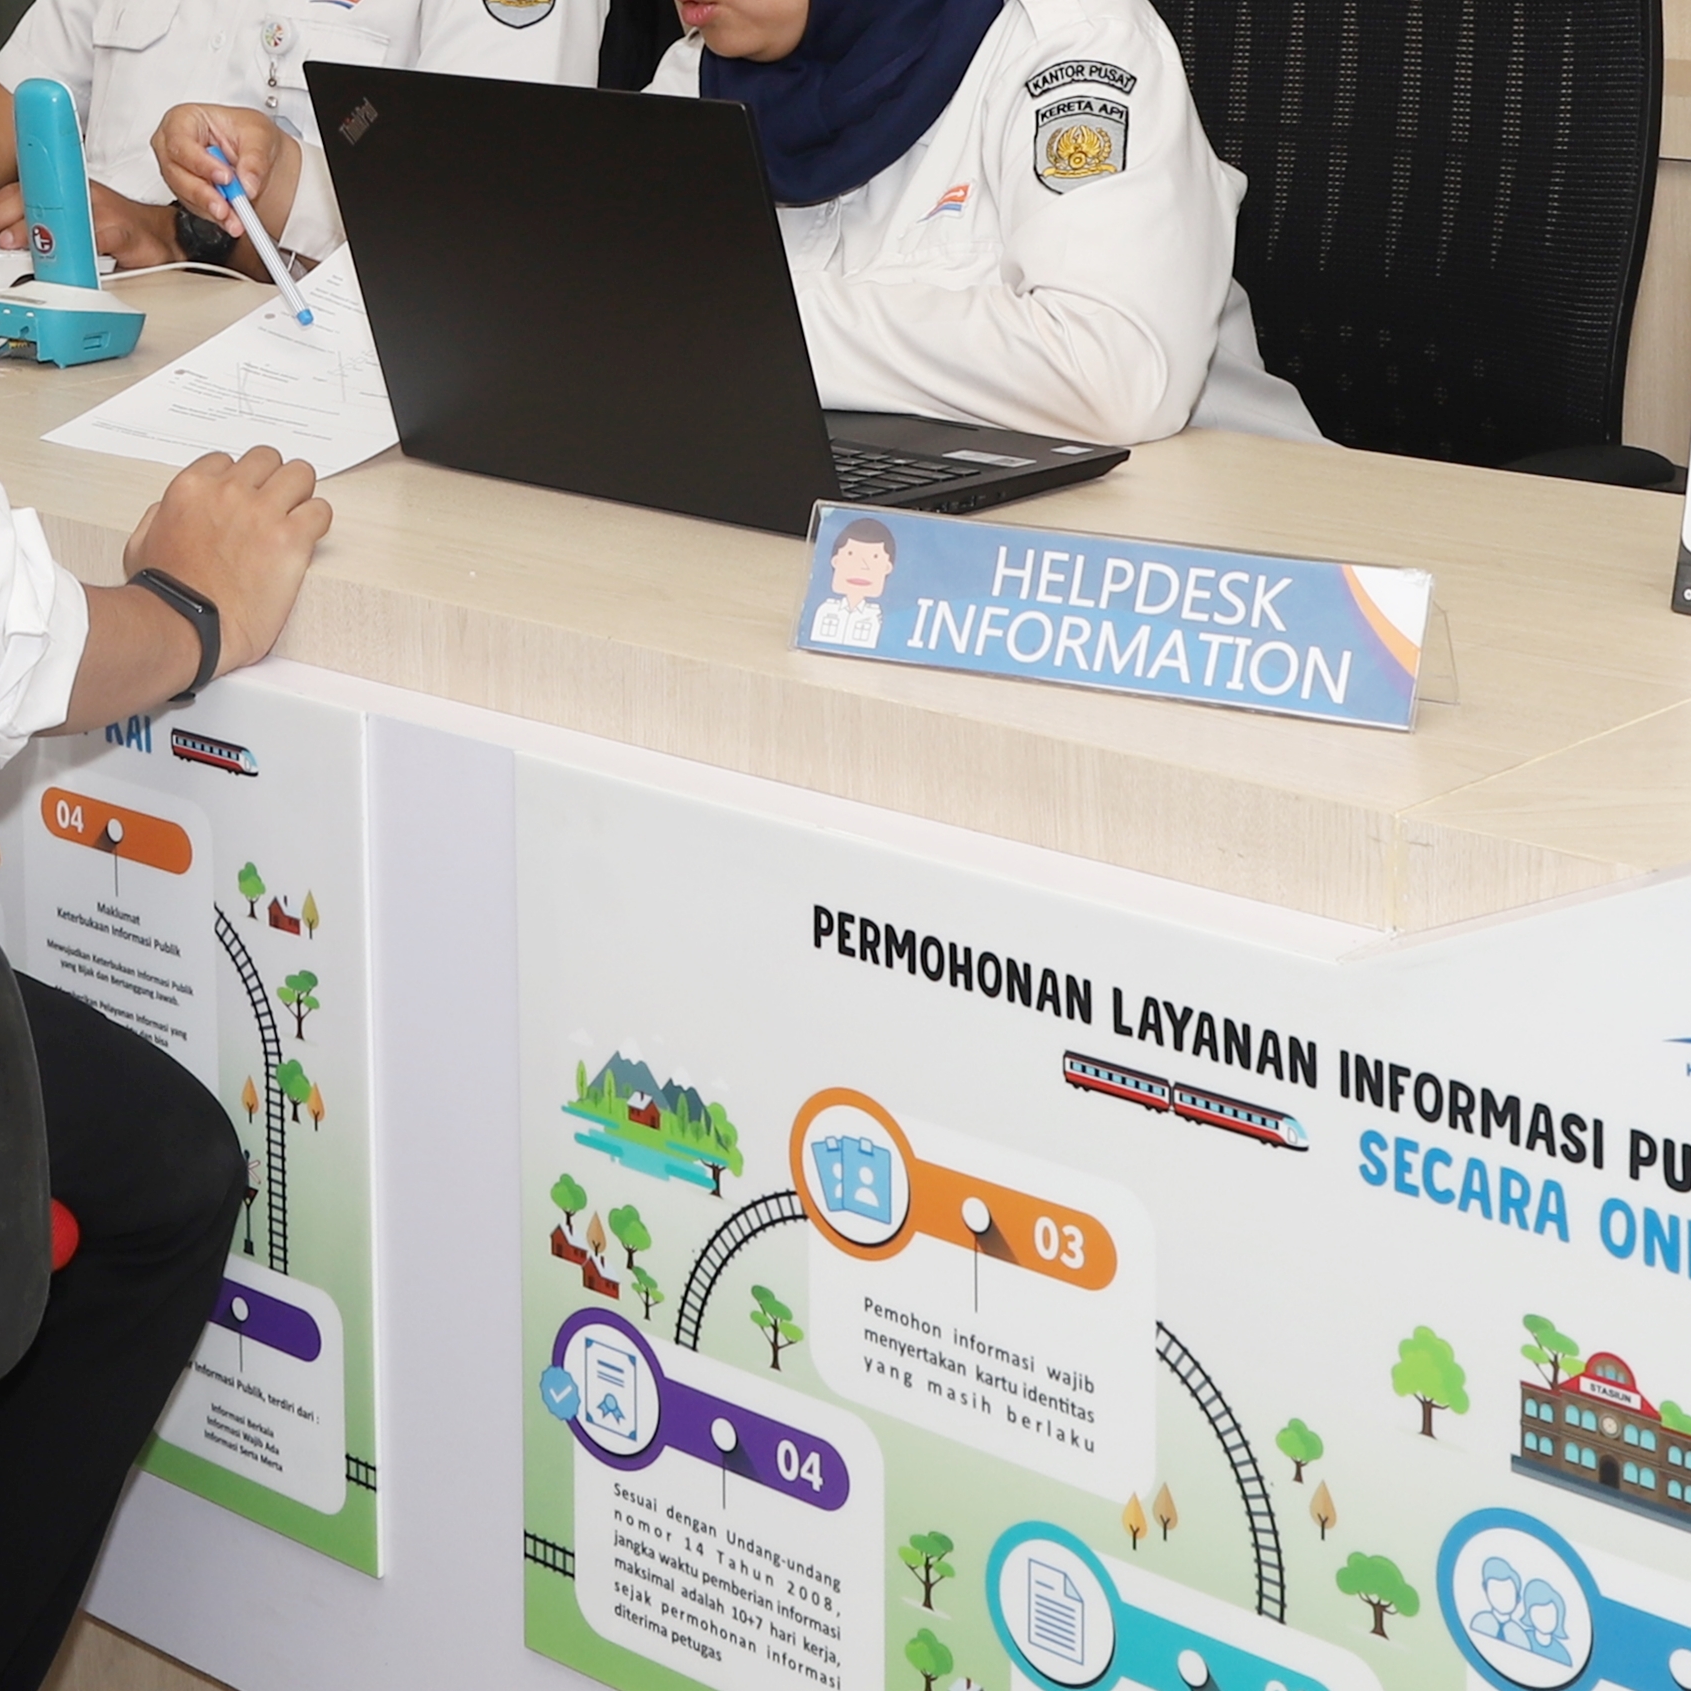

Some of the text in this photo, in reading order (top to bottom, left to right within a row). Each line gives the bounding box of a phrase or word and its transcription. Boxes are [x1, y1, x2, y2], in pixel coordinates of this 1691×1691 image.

[1032, 65, 1132, 91] KANTOR PUSAT
[339, 97, 378, 145] ThinkPad
[1040, 100, 1125, 122] KERETA API
[991, 545, 1293, 632] HELPDESK
[907, 599, 1352, 704] INFORMATION
[56, 800, 84, 833] 04
[57, 907, 181, 957] Keterbukaan Informasi Publik
[97, 902, 140, 925] Maklumat
[47, 938, 194, 996] Mewujudkan Keterbukaan Informasi Publik
[60, 960, 76, 973] yang
[78, 965, 94, 977] Bijak
[96, 971, 109, 981] dan
[111, 976, 155, 1000] Bertanggung
[99, 1000, 134, 1020] Pelayanan
[135, 1013, 169, 1032] Informasi
[170, 1027, 187, 1041] yang
[812, 904, 1093, 1025] PERMOHONAN
[1112, 986, 1318, 1090] LAYANAN
[1339, 1049, 1604, 1170] INFORMASI
[1358, 1129, 1570, 1243] SECARA
[1033, 1215, 1085, 1270] 03
[864, 1297, 1095, 1394] Pemohon informasi wajib
[194, 1361, 314, 1421] Informasi Publik, terdiri dari
[863, 1356, 1095, 1453] yang masih berlaku
[864, 1328, 1095, 1424] menyertakan kartu identitas
[1590, 1383, 1631, 1403] STASIUN
[207, 1415, 279, 1455] Informasi Wajib Ada
[211, 1403, 274, 1438] Informasi Berkala
[204, 1429, 283, 1472] Informasi Serta Merta
[776, 1439, 824, 1493] 04
[613, 1482, 841, 1594] Sesuai dengan Undang-undang
[614, 1509, 841, 1617] nomor 14 Tahun 2008,
[613, 1530, 841, 1640] jangka waktu pemberian informasi
[614, 1556, 841, 1668] maksimal adalah 10+7 hari kerja,
[614, 1603, 723, 1662] diterima petugas
[614, 1582, 841, 1691] sejak permohonan informasi
